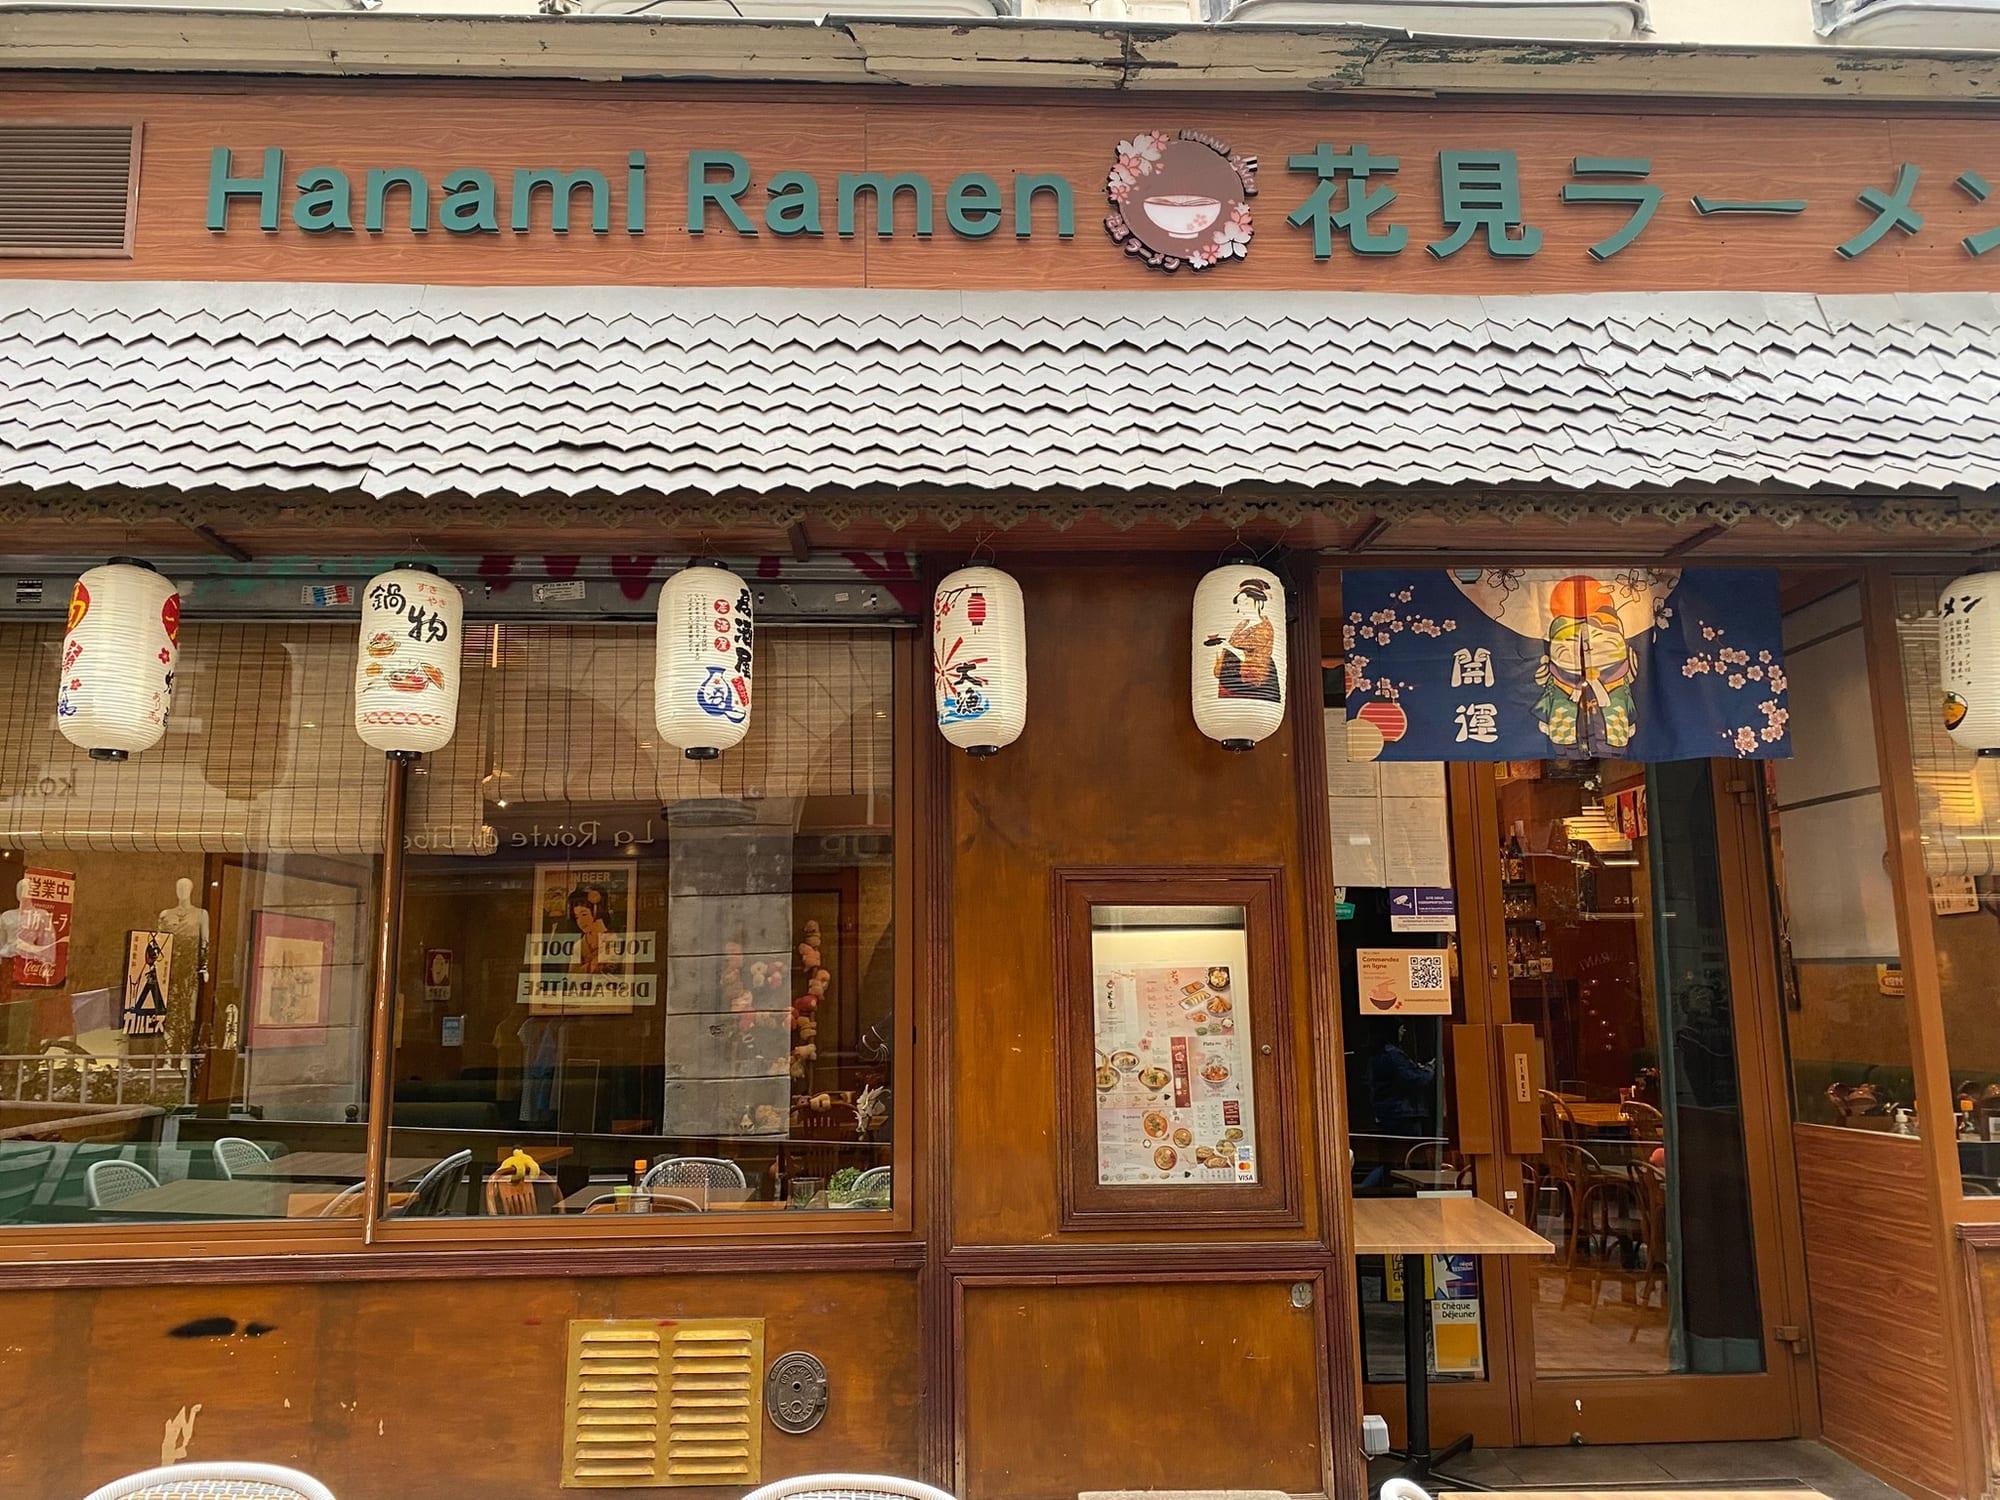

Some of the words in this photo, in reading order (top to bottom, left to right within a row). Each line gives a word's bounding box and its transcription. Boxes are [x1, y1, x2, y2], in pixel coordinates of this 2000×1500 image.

[205, 146, 647, 235] Hanami
[687, 149, 1077, 240] Ramen
[1937, 596, 1983, 620] メン
[953, 661, 984, 714] 大漁
[28, 877, 70, 900] 営業中
[122, 1012, 167, 1034] カルピス
[1441, 1302, 1471, 1311] Chèque
[1442, 1311, 1476, 1320] Déjeuner
